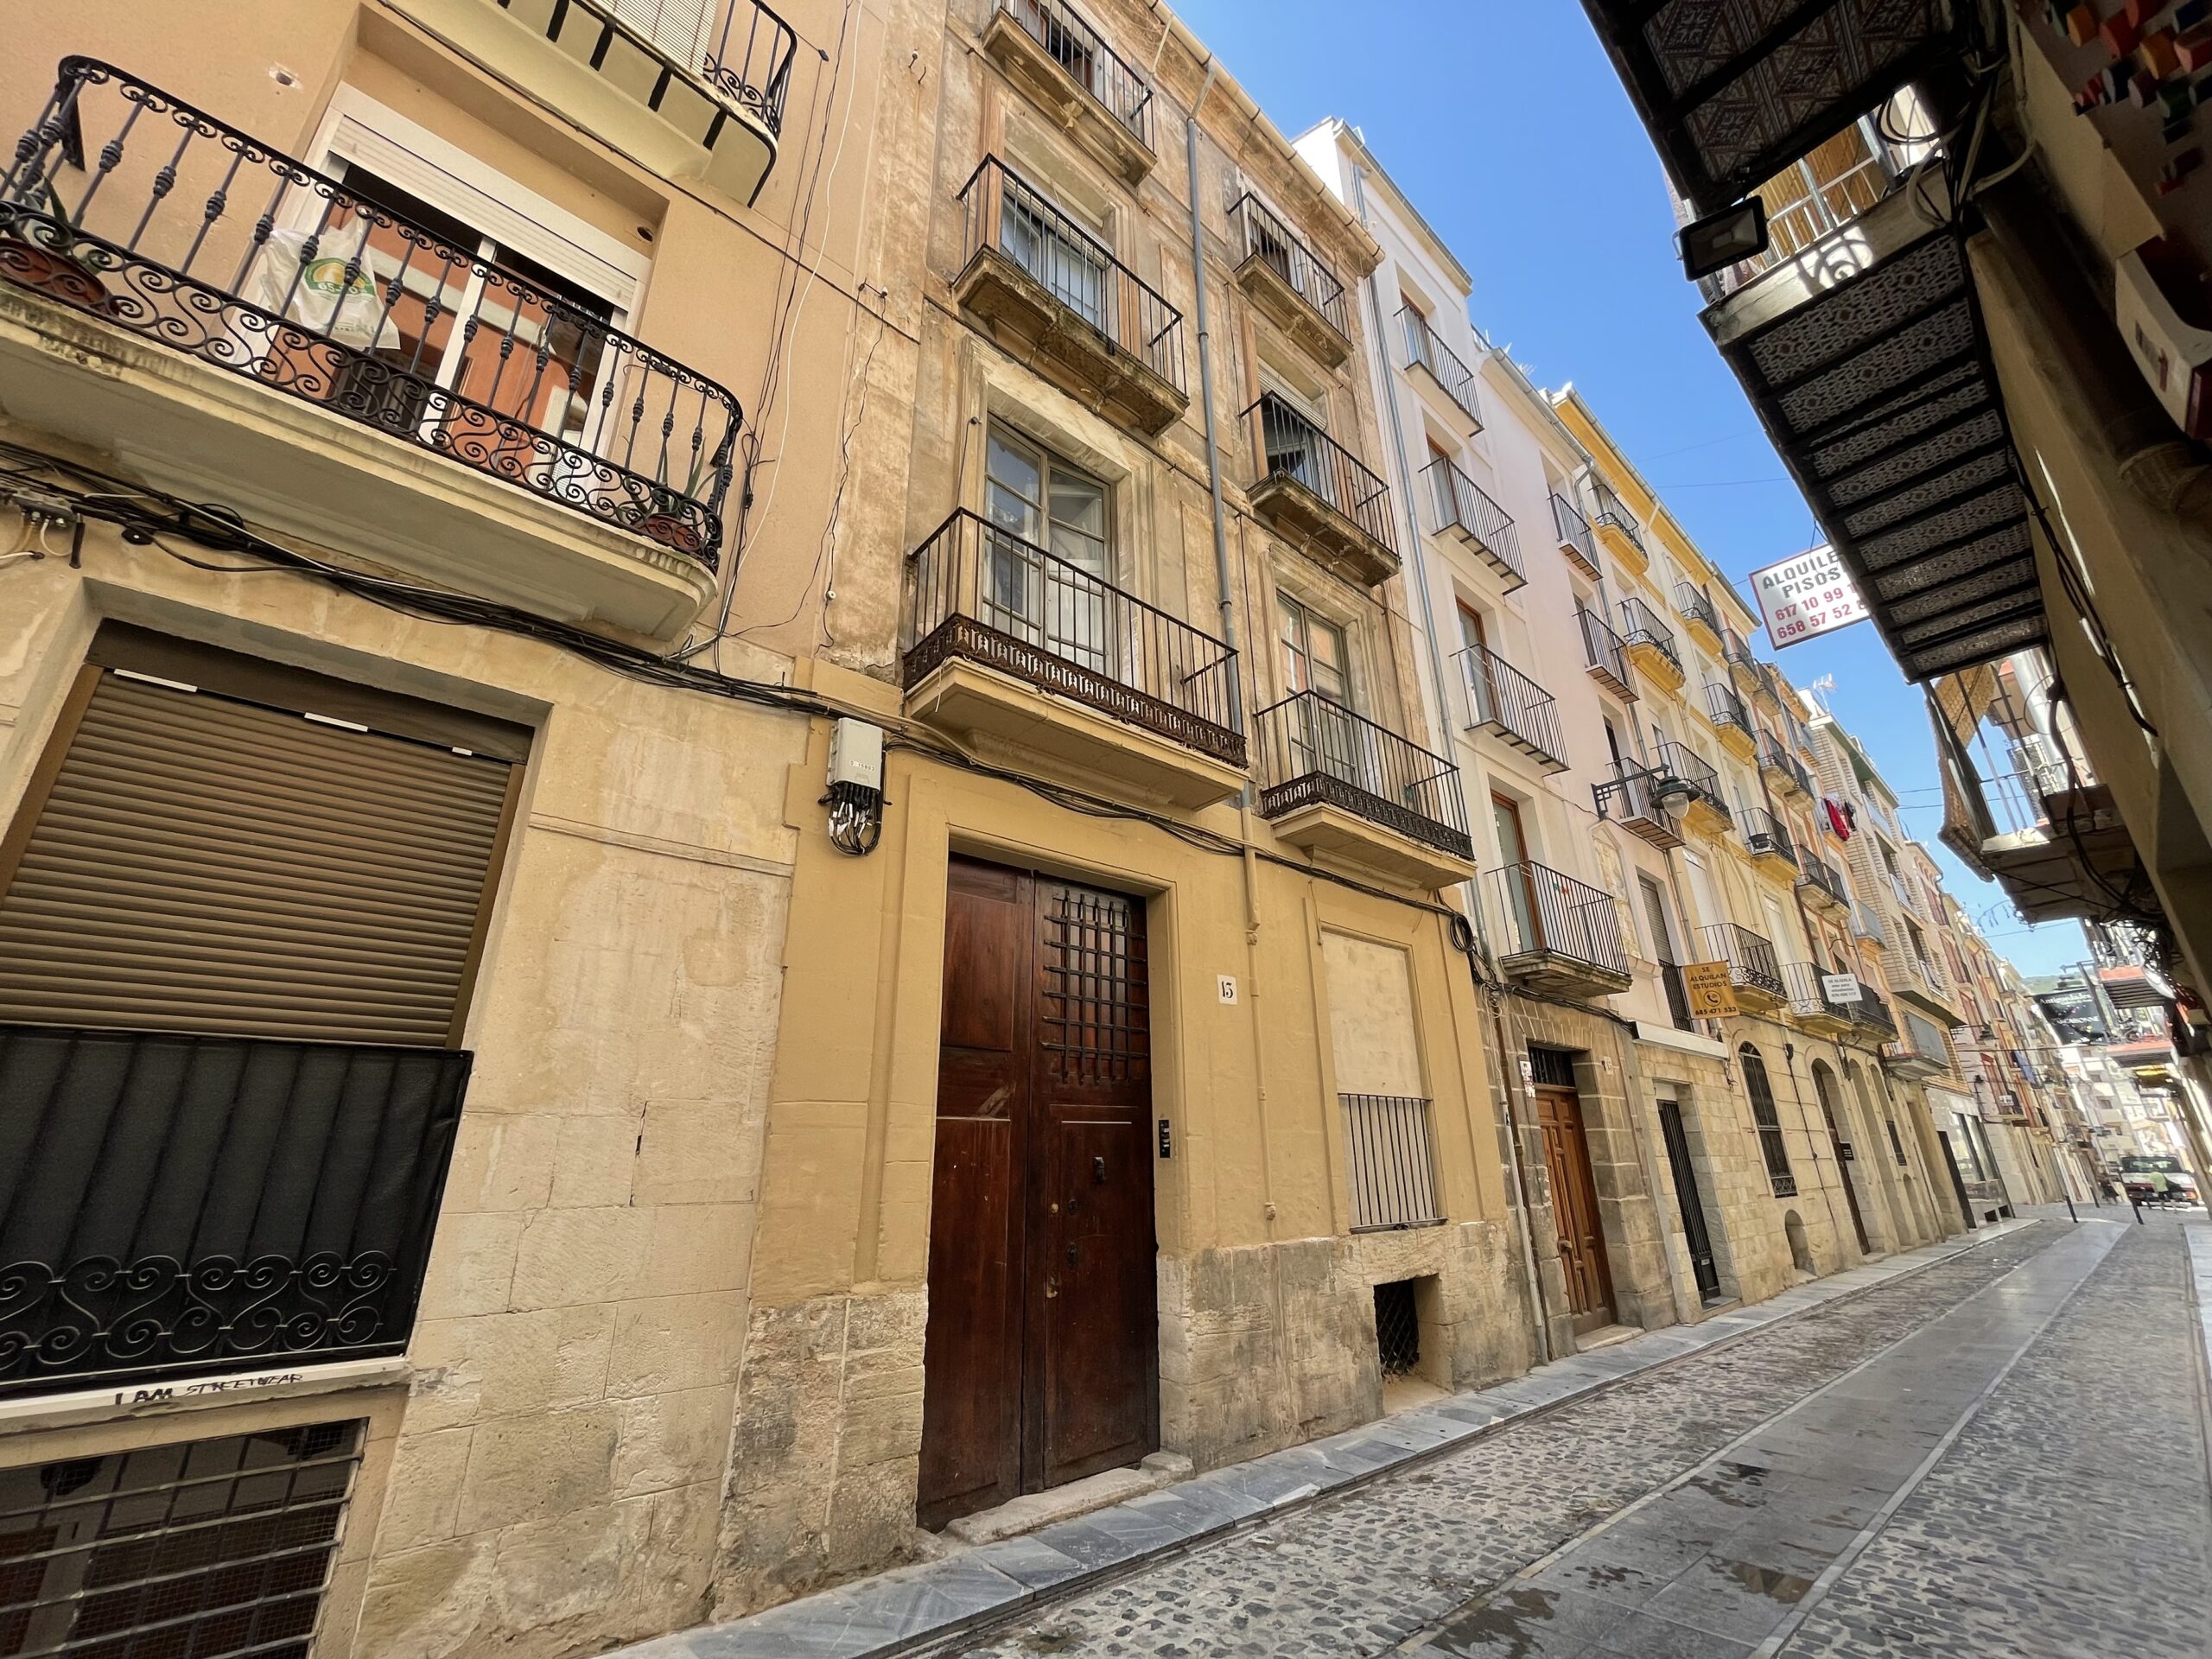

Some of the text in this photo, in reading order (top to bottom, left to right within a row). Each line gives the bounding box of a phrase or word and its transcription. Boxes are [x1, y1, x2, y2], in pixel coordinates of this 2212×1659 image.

[1763, 550, 1840, 589] ALQUILE
[1782, 567, 1841, 598] PISOS
[1775, 603, 1798, 621] 617
[1802, 596, 1819, 612] 10
[1823, 587, 1844, 603] 99
[1777, 620, 1806, 639] 658
[1809, 612, 1827, 628] 57
[1833, 603, 1853, 620] 52
[1689, 973, 1726, 982] ALQUILAN
[1693, 981, 1727, 990] ESTUDIOS
[114, 1392, 124, 1406] I
[132, 1388, 174, 1403] AM
